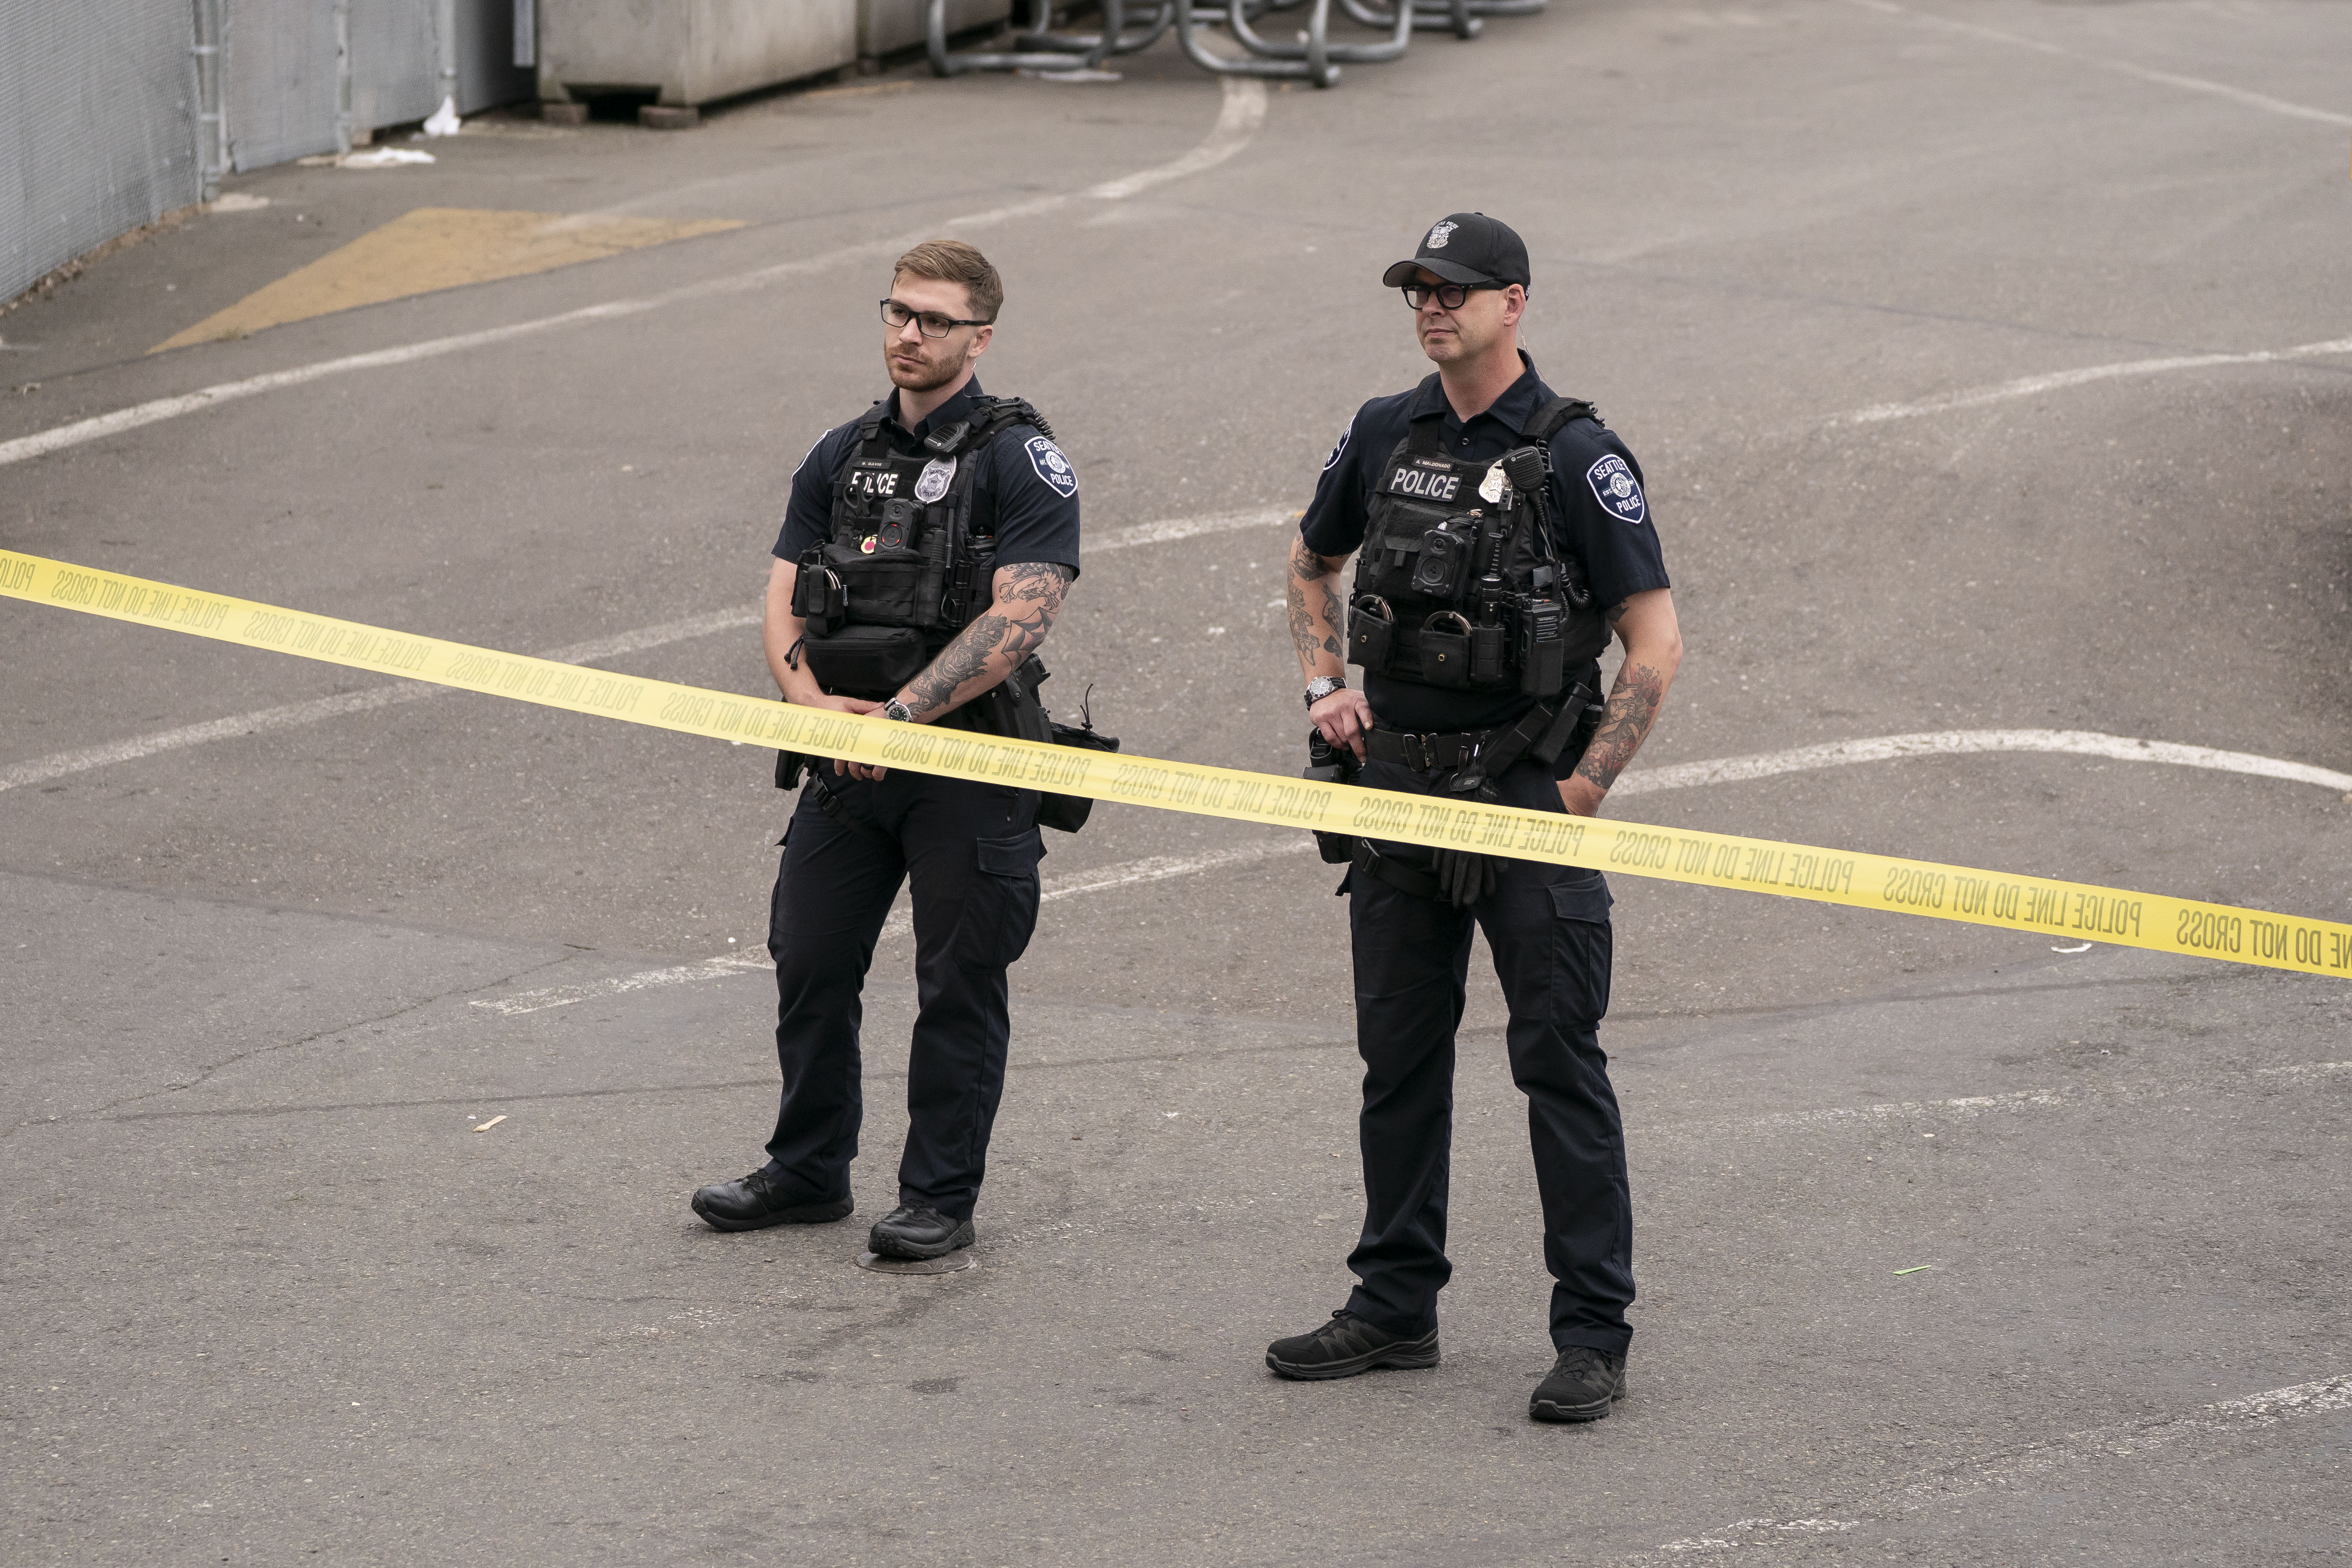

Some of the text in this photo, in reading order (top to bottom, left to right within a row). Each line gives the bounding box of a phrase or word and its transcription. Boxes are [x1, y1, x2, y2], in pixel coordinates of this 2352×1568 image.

[1033, 440, 1062, 456] SEATTLE
[1422, 460, 1451, 469] MALDONADO
[1594, 460, 1625, 480] SEATTLE
[1050, 473, 1074, 486] POLICE
[1391, 468, 1459, 499] POLICE
[1603, 488, 1613, 496] EST.
[1616, 495, 1641, 513] POLICE
